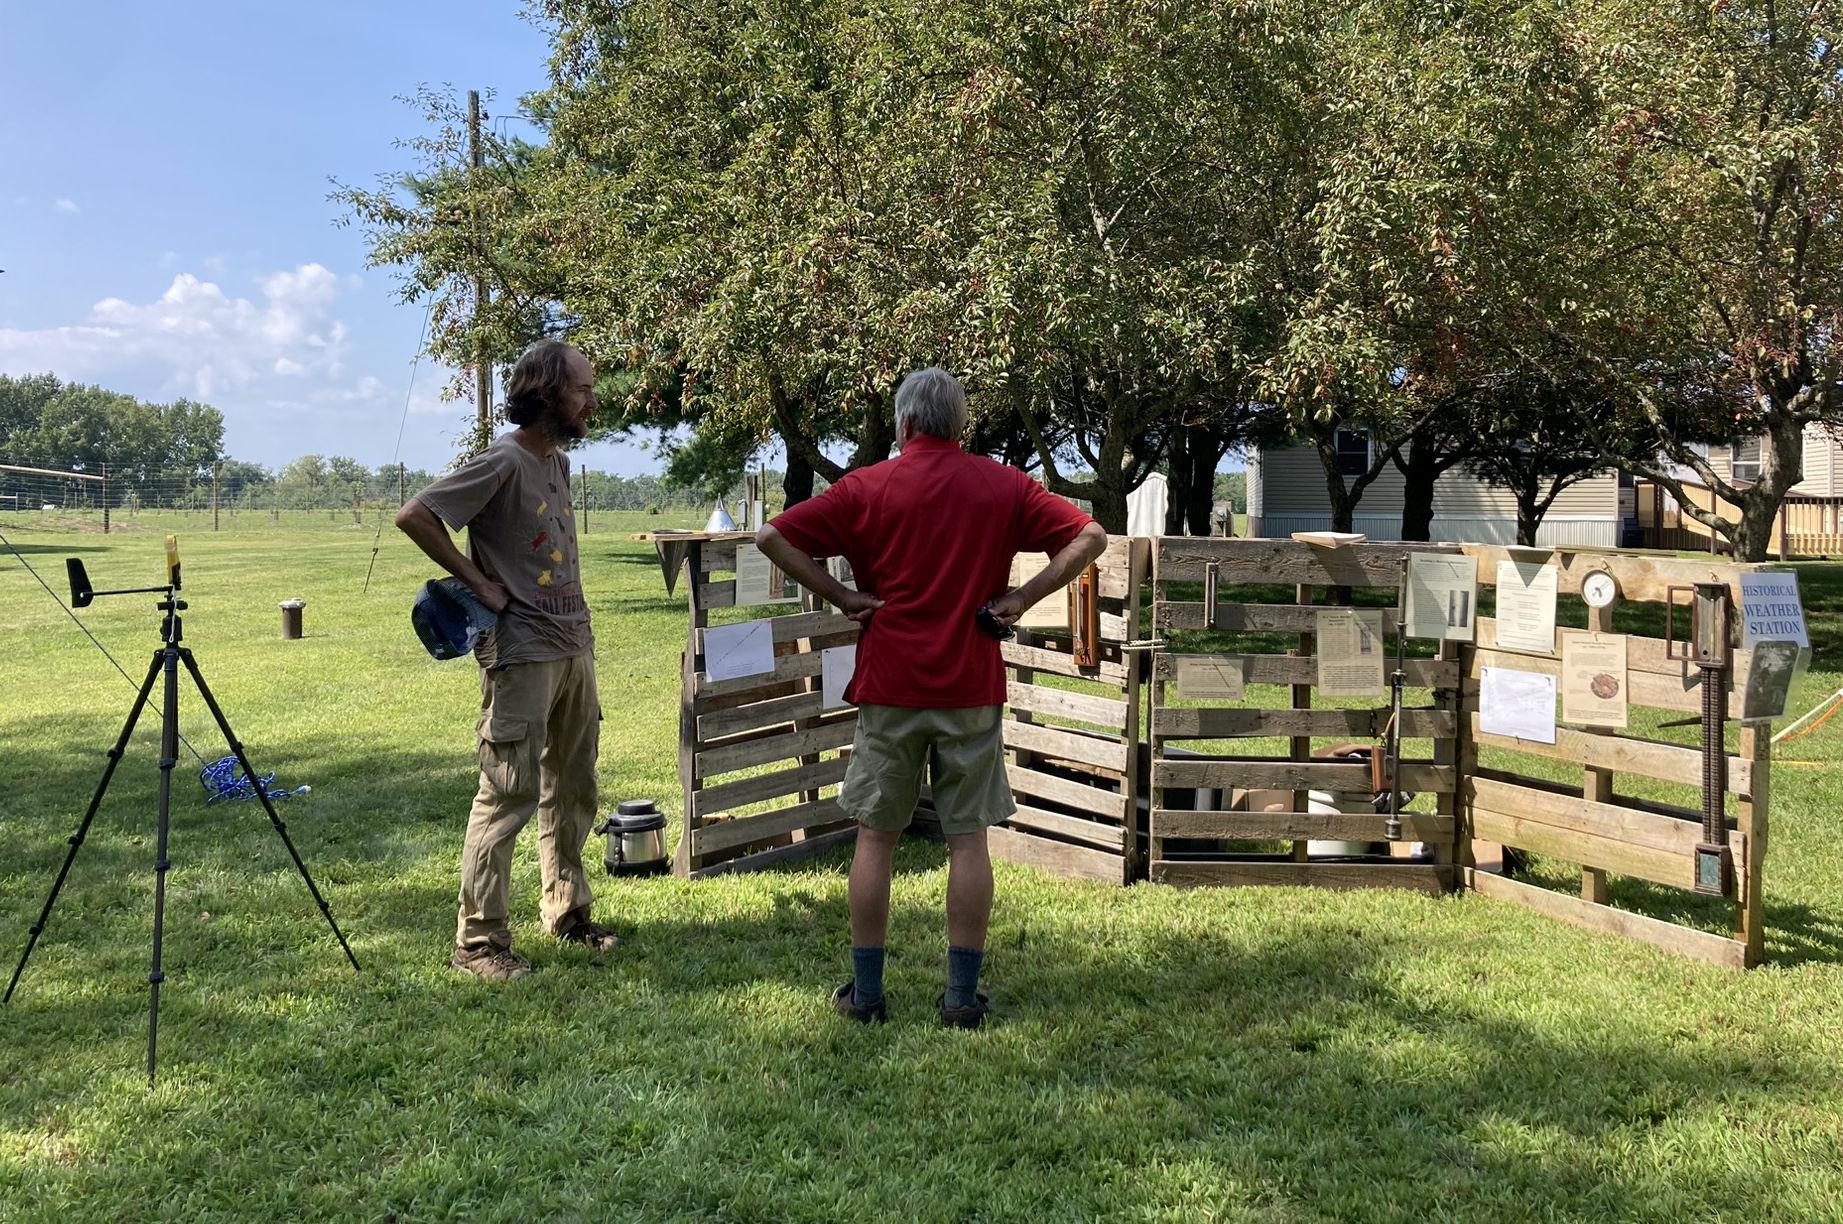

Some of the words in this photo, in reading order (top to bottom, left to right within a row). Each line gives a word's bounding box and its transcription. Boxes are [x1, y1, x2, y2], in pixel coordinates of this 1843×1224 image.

[1743, 585, 1796, 596] HISTORICAL
[1744, 603, 1800, 617] WEATHER
[1750, 621, 1800, 635] STATION
